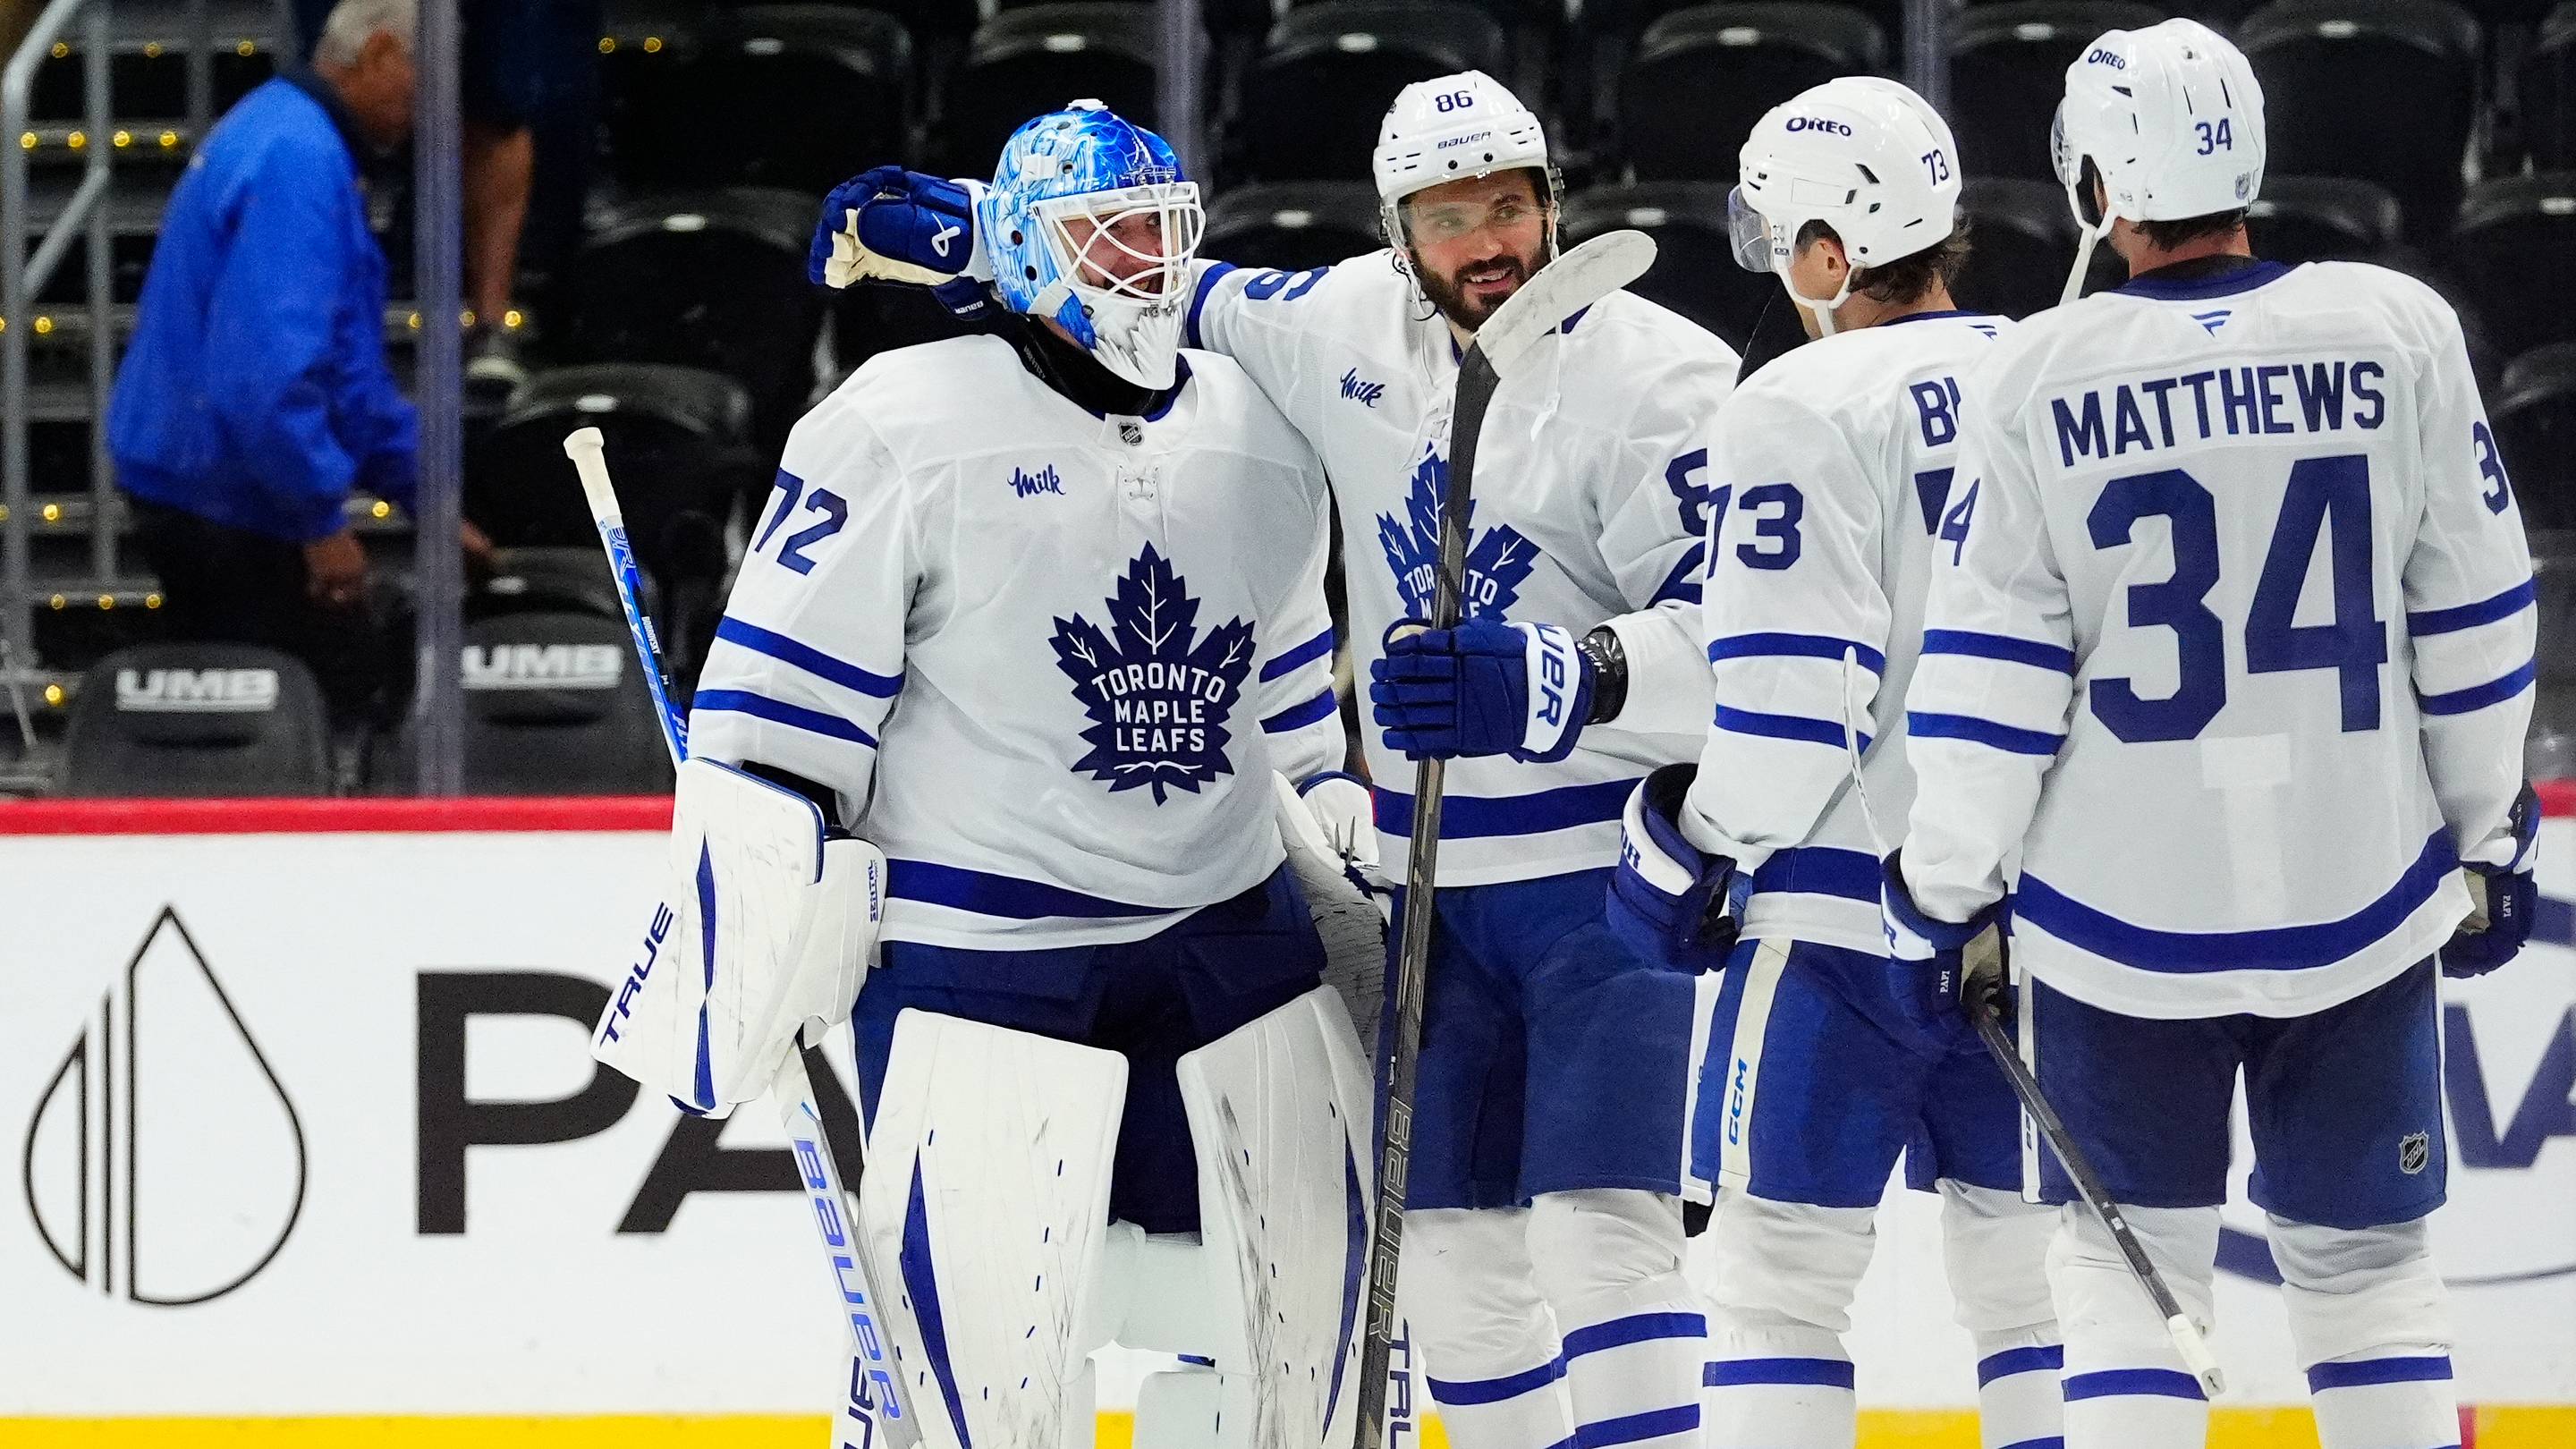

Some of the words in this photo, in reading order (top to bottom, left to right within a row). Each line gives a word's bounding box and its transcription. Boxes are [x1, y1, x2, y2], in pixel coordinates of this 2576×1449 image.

[2088, 48, 2126, 70] OREO
[1436, 90, 1474, 113] 86
[1785, 116, 1852, 137] OREO
[2194, 117, 2233, 156] 34
[1921, 148, 1950, 187] 73
[2051, 360, 2385, 468] MATTHEWS
[754, 466, 849, 577] 72
[1706, 481, 1804, 580] 73
[1403, 564, 1499, 606] TORTO
[2086, 453, 2388, 744] 34
[461, 644, 623, 677] UMB
[116, 669, 277, 701] UMB
[1091, 662, 1226, 704] TORONTO
[1114, 699, 1206, 724] MAPLE
[1115, 727, 1205, 753] LEAFS
[598, 902, 674, 1049] TRUE
[1939, 970, 1951, 994] PAPI
[1728, 1057, 1747, 1138] CCM
[1368, 1095, 1413, 1344] BAUER
[793, 1139, 902, 1420] BAUER
